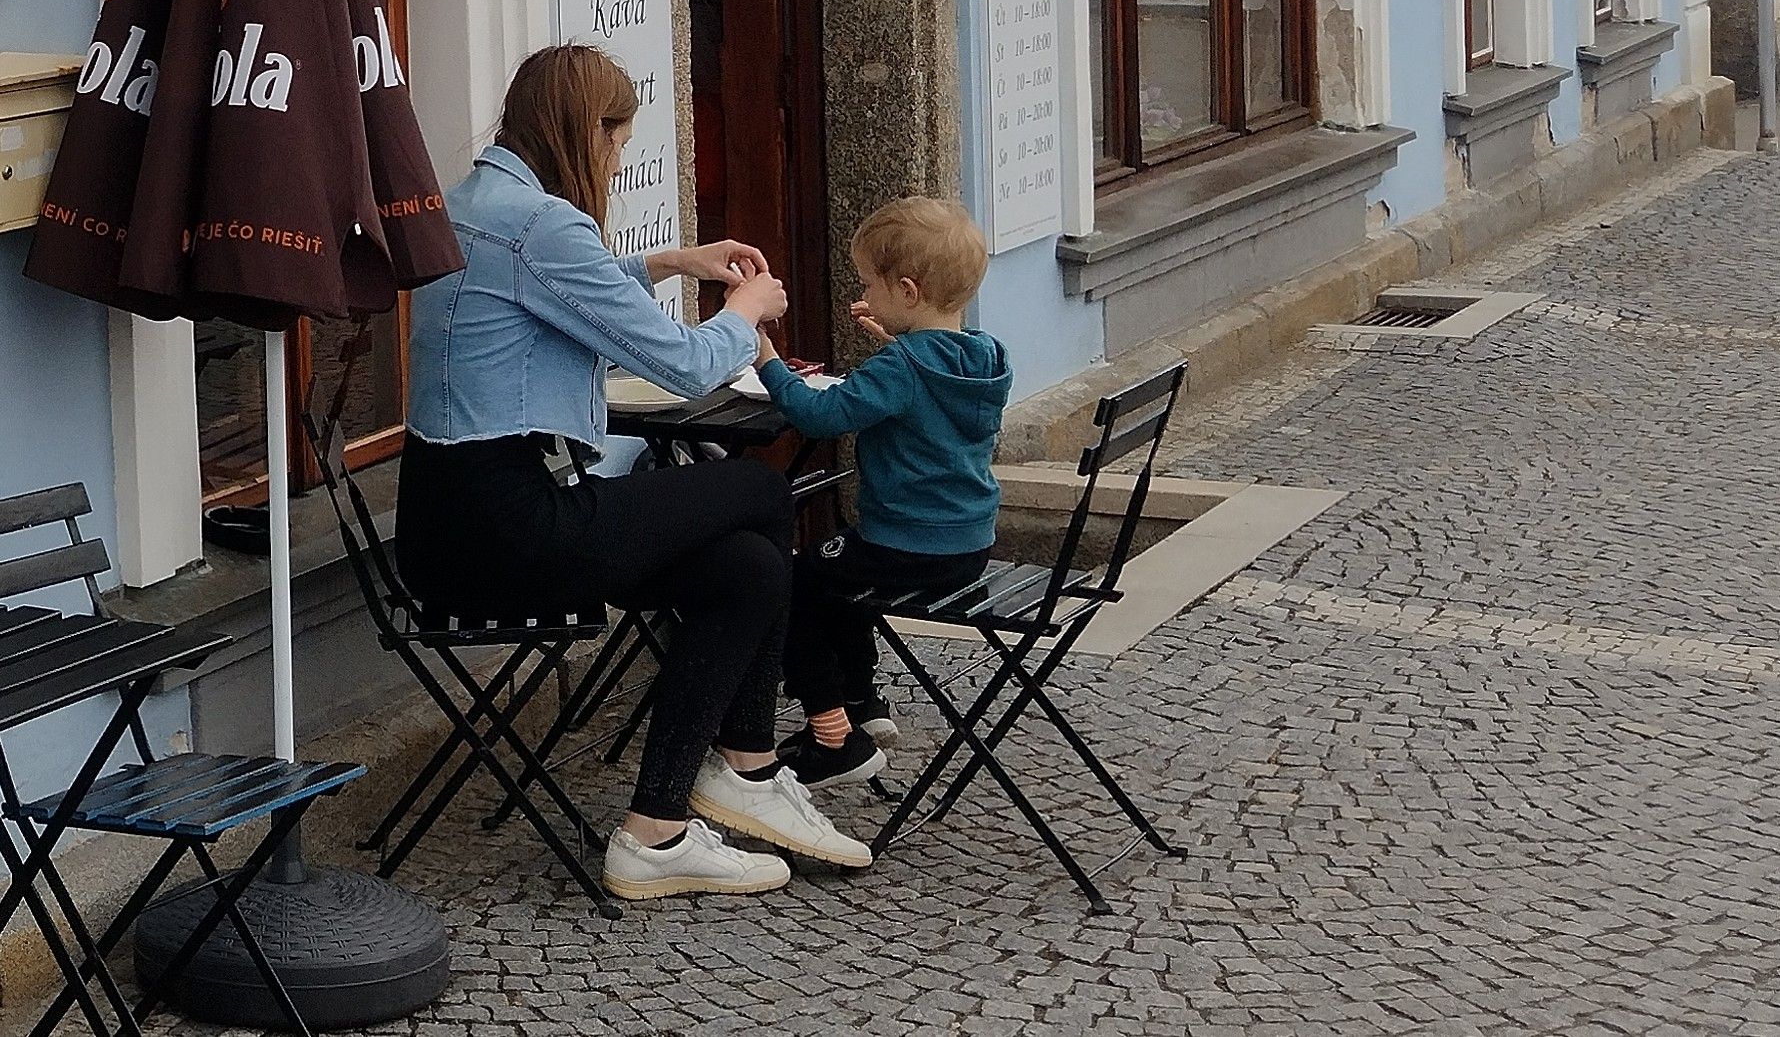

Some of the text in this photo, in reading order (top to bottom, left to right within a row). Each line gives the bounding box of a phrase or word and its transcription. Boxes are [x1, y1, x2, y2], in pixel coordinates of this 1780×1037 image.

[353, 6, 406, 92] ol
[994, 42, 1005, 63] St
[998, 148, 1008, 168] So
[425, 194, 443, 211] CO
[83, 217, 109, 236] CO
[228, 219, 254, 239] ČO
[261, 227, 323, 254] RIEŠIŤ
